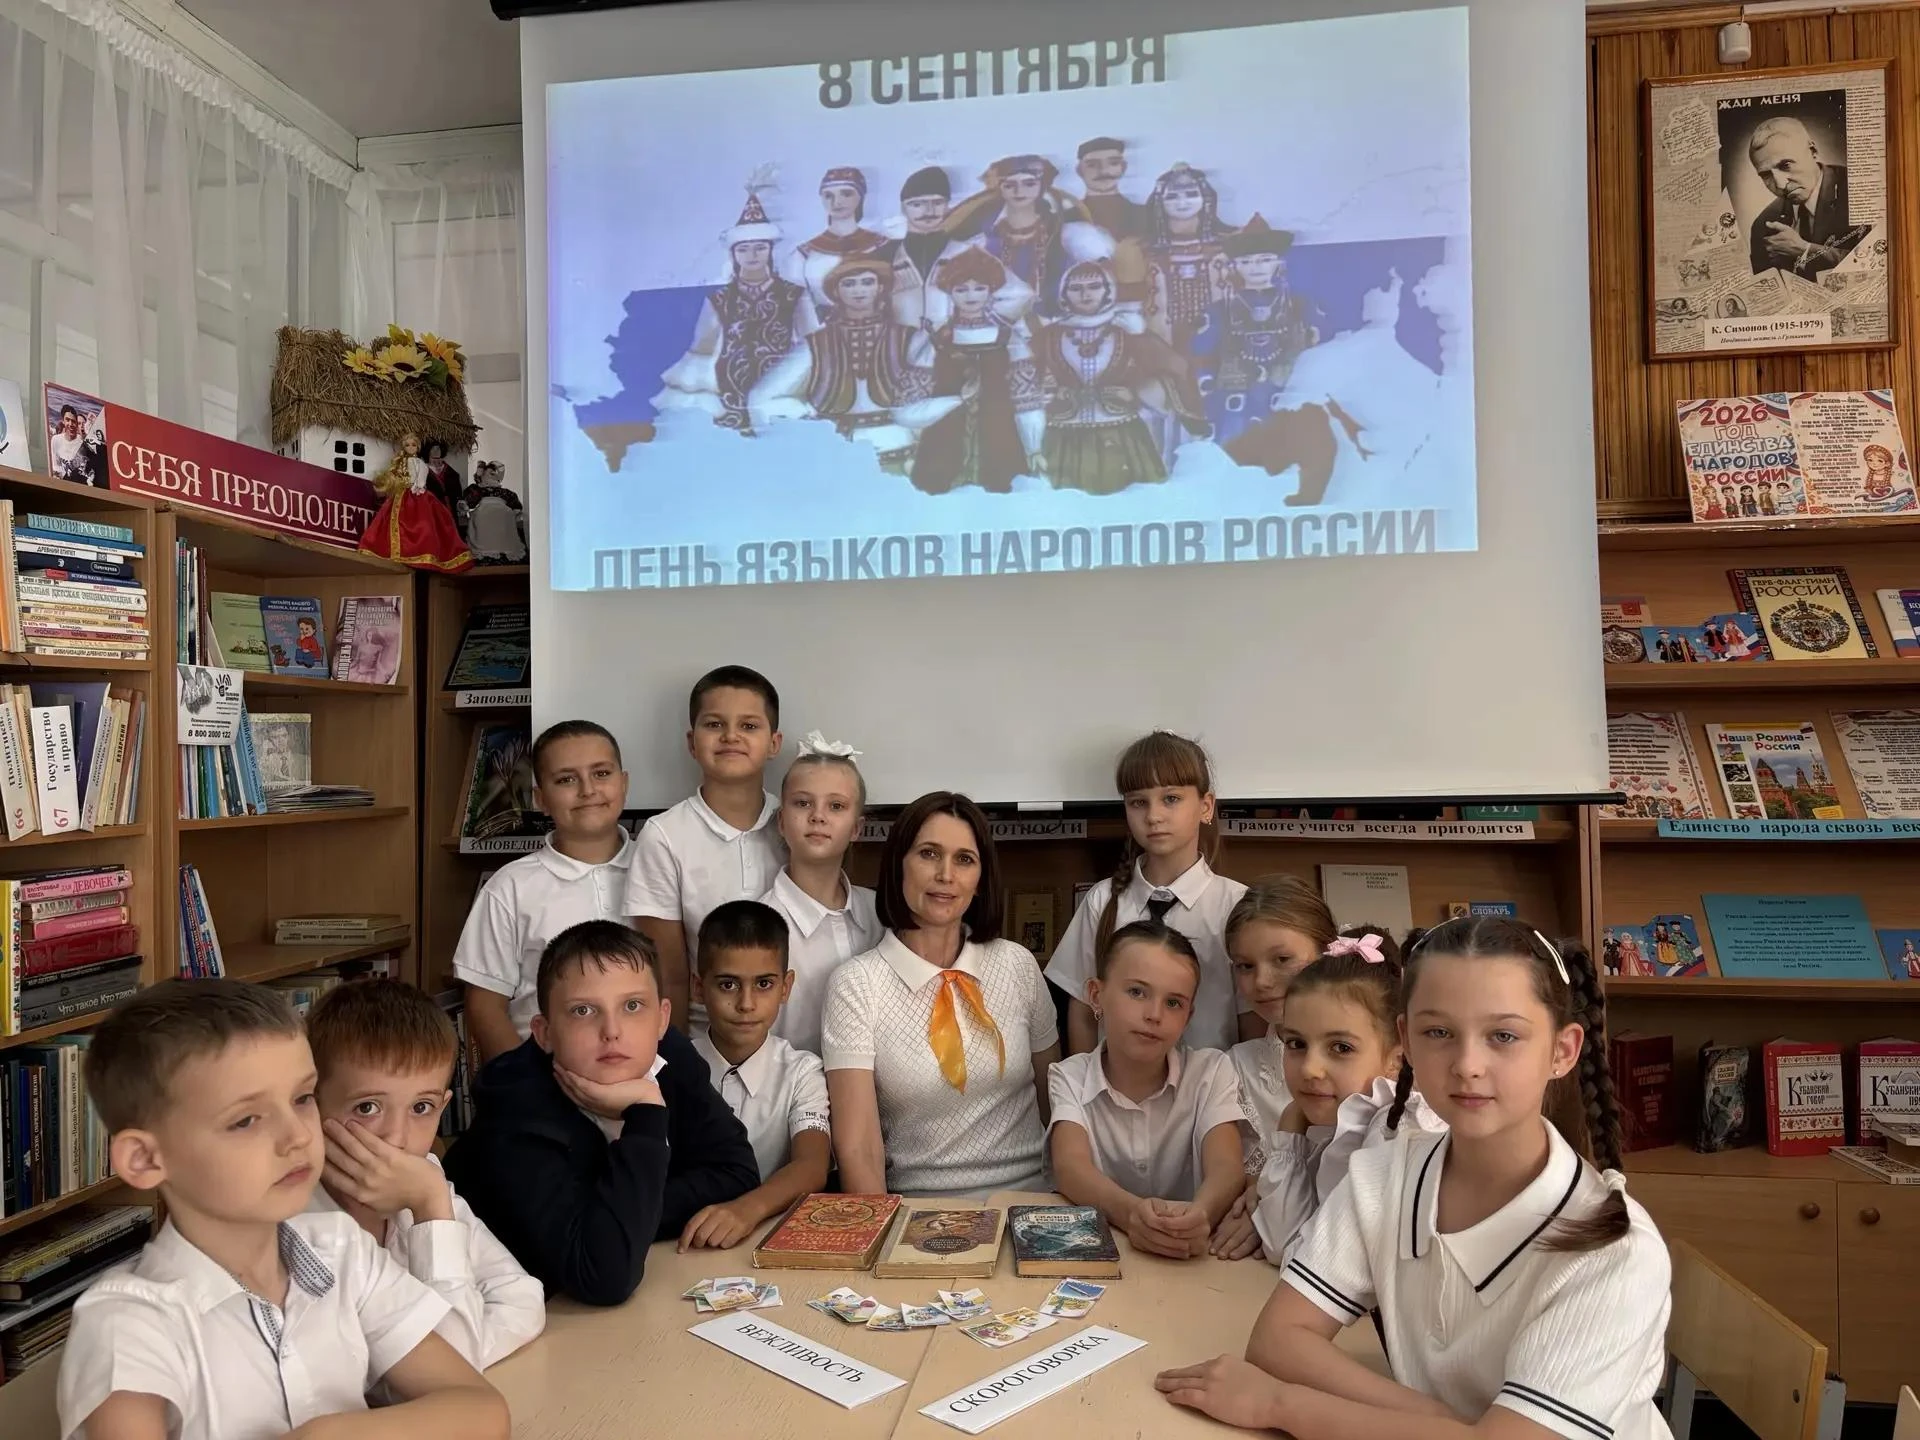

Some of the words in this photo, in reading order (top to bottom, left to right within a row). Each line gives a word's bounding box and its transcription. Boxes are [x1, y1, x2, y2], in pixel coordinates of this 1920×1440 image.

[819, 61, 852, 109] 8
[871, 35, 1165, 105] СЕНТЯБРЯ
[1760, 93, 1801, 105] МЕНЯ
[1711, 325, 1722, 334] К.
[1724, 324, 1768, 334] Симонов
[1770, 319, 1824, 332] (1915-1979)
[1699, 402, 1768, 426] 2026
[1714, 423, 1759, 440] ГОД
[1686, 435, 1793, 457] ЕДИНСТВА
[1692, 452, 1793, 471] НАРОДОВ
[1703, 468, 1786, 486] РОССИИ
[112, 441, 202, 497] СЕБЯ
[210, 467, 378, 535] ПРЕОДОЛЕТ
[32, 514, 79, 534] ИСТОРИЯ
[80, 522, 118, 538] РОССИИ
[588, 545, 722, 590] ДЕНЬ
[737, 535, 945, 584] ЯЗЫКОВ
[961, 521, 1206, 576] НАРОДОВ
[1223, 509, 1436, 563] РОССИИ
[20, 586, 50, 597] ОЛЬШАЯ
[1754, 584, 1841, 598] РОССИИ
[59, 723, 73, 761] право
[188, 729, 193, 737] 8
[194, 729, 207, 737] 800
[208, 730, 221, 738] 2000
[222, 731, 231, 739] 122
[1718, 733, 1755, 742] Наша
[1756, 733, 1811, 743] Родина-
[43, 711, 58, 791] Государство
[1755, 742, 1801, 751] Россия
[14, 807, 25, 830] 66
[54, 808, 69, 828] 67
[990, 822, 1082, 837] ОТНОСТИ
[1228, 819, 1295, 833] Грамоте
[1299, 822, 1355, 836] учится
[1364, 824, 1417, 836] всегда
[1428, 823, 1524, 838] пригодится
[1669, 819, 1750, 834] Единство
[1760, 824, 1820, 837] народа
[1825, 824, 1884, 835] сквозь
[72, 876, 113, 894] ДЕВОЧЕК
[58, 1003, 74, 1015] Что
[75, 998, 99, 1011] такое
[100, 993, 114, 1005] Кто
[114, 986, 137, 1000] такой
[1870, 1075, 1920, 1106] КУБАНСКИ
[736, 1322, 866, 1383] ВЕЖЛИВОСТЬ
[949, 1332, 1107, 1414] СКОРОГОВОРКА
